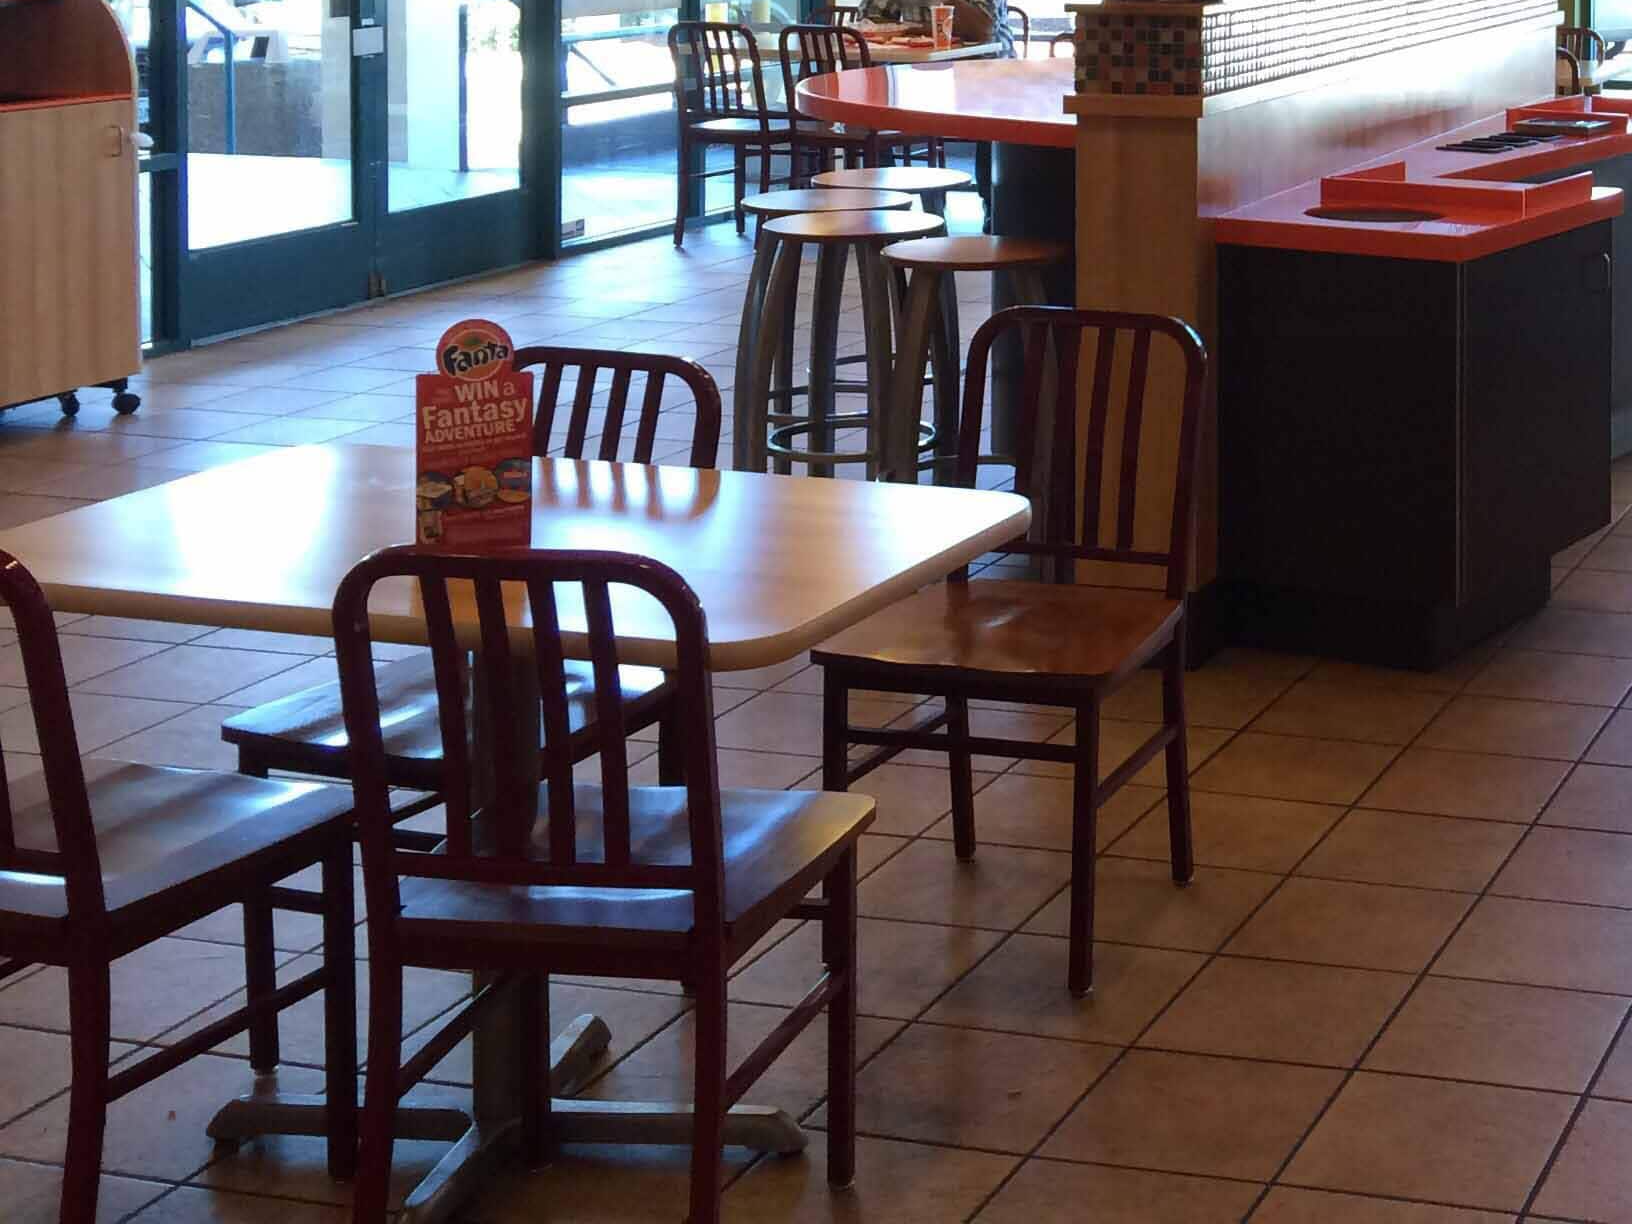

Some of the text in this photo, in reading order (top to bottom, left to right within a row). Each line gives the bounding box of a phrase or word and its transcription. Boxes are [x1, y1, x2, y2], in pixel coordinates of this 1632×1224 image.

[443, 341, 509, 376] Fanta
[455, 382, 515, 402] WIN a
[422, 397, 528, 429] Fantasy
[423, 421, 515, 445] ADVENTURE
